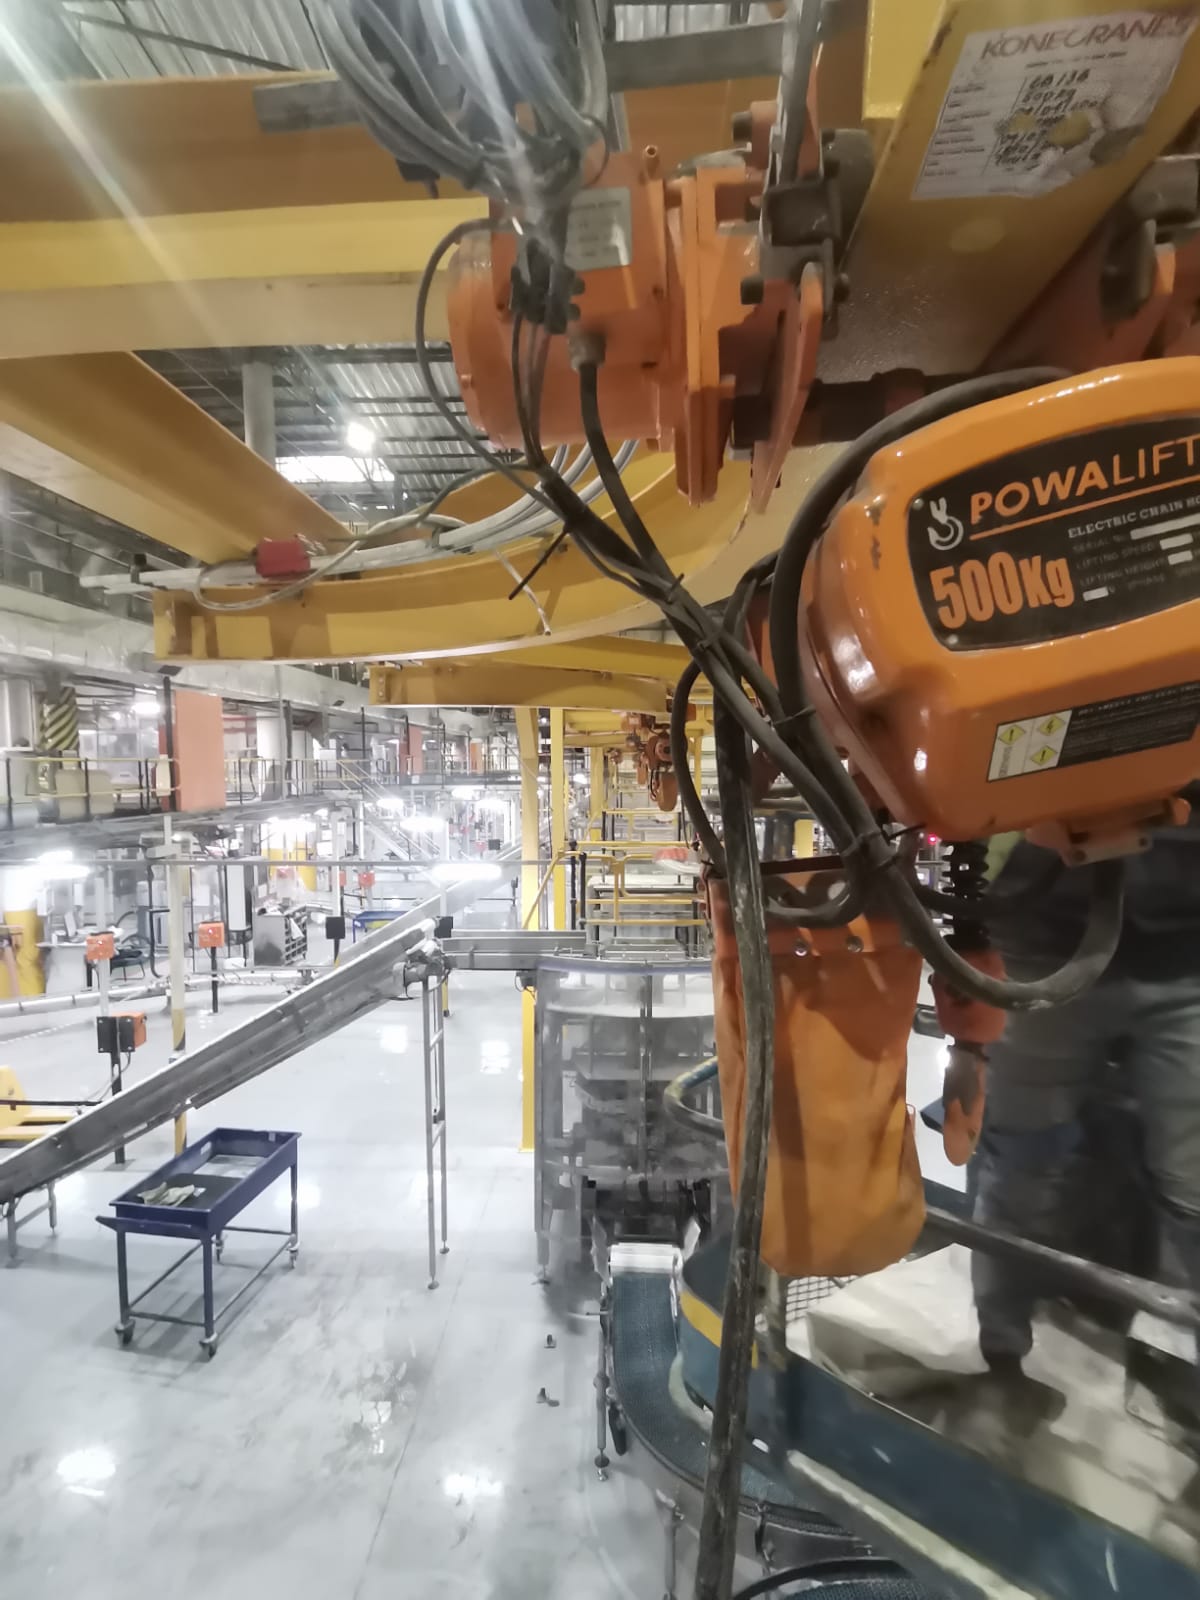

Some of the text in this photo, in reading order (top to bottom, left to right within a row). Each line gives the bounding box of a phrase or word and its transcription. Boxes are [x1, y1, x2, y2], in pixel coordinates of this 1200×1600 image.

[970, 433, 1200, 525] POWALIFT
[1067, 511, 1137, 539] ELECTRIC
[1139, 500, 1184, 520] CHAIN
